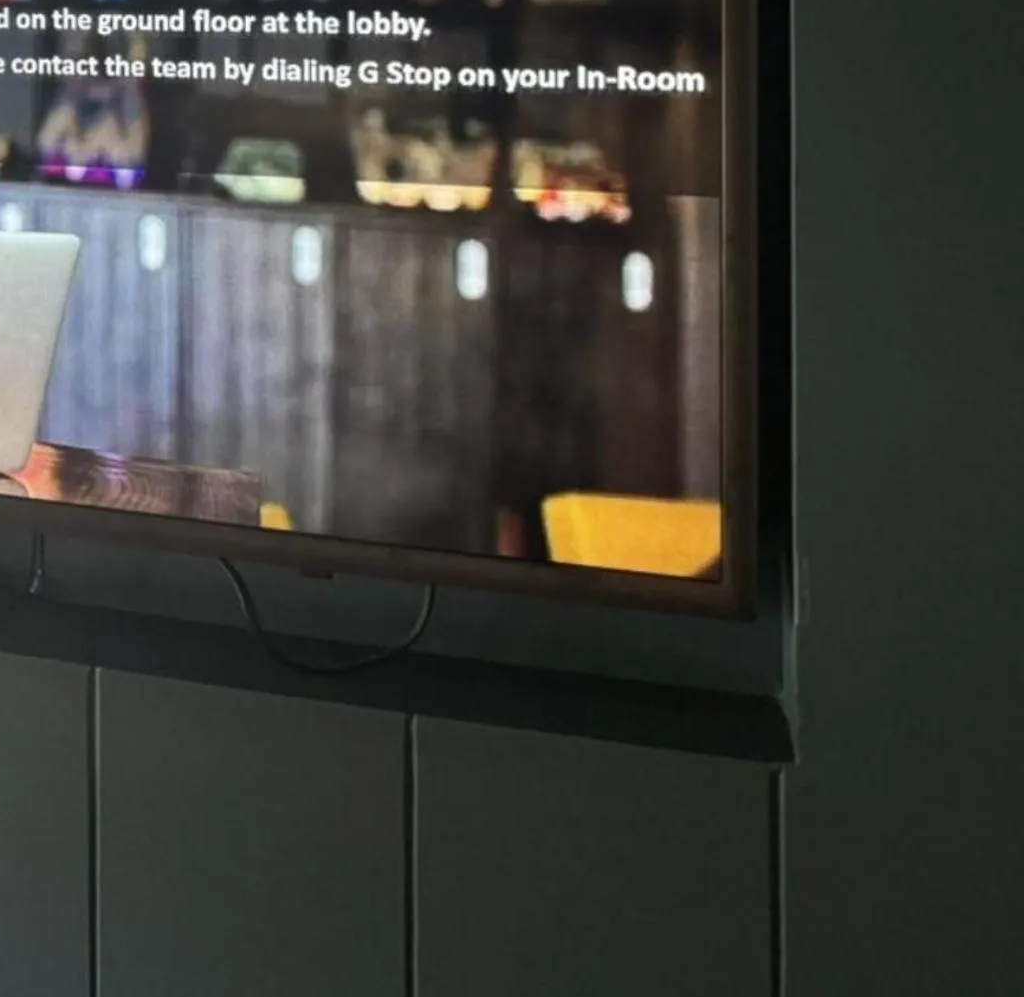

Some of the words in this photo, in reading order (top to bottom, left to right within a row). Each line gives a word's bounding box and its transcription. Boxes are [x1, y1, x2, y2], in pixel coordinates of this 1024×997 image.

[16, 12, 46, 31] on
[52, 7, 92, 31] the
[97, 9, 186, 36] ground
[192, 9, 256, 35] floor
[262, 12, 291, 34] at
[295, 10, 340, 35] the
[347, 10, 432, 41] lobby.
[11, 56, 99, 77] contact
[104, 54, 146, 78] the
[151, 57, 217, 80] team
[224, 58, 255, 85] by
[262, 58, 352, 88] dialing
[358, 61, 380, 84] G
[387, 61, 451, 90] Stop
[458, 69, 496, 87] on
[503, 68, 569, 93] your
[578, 65, 706, 94] In-Room
